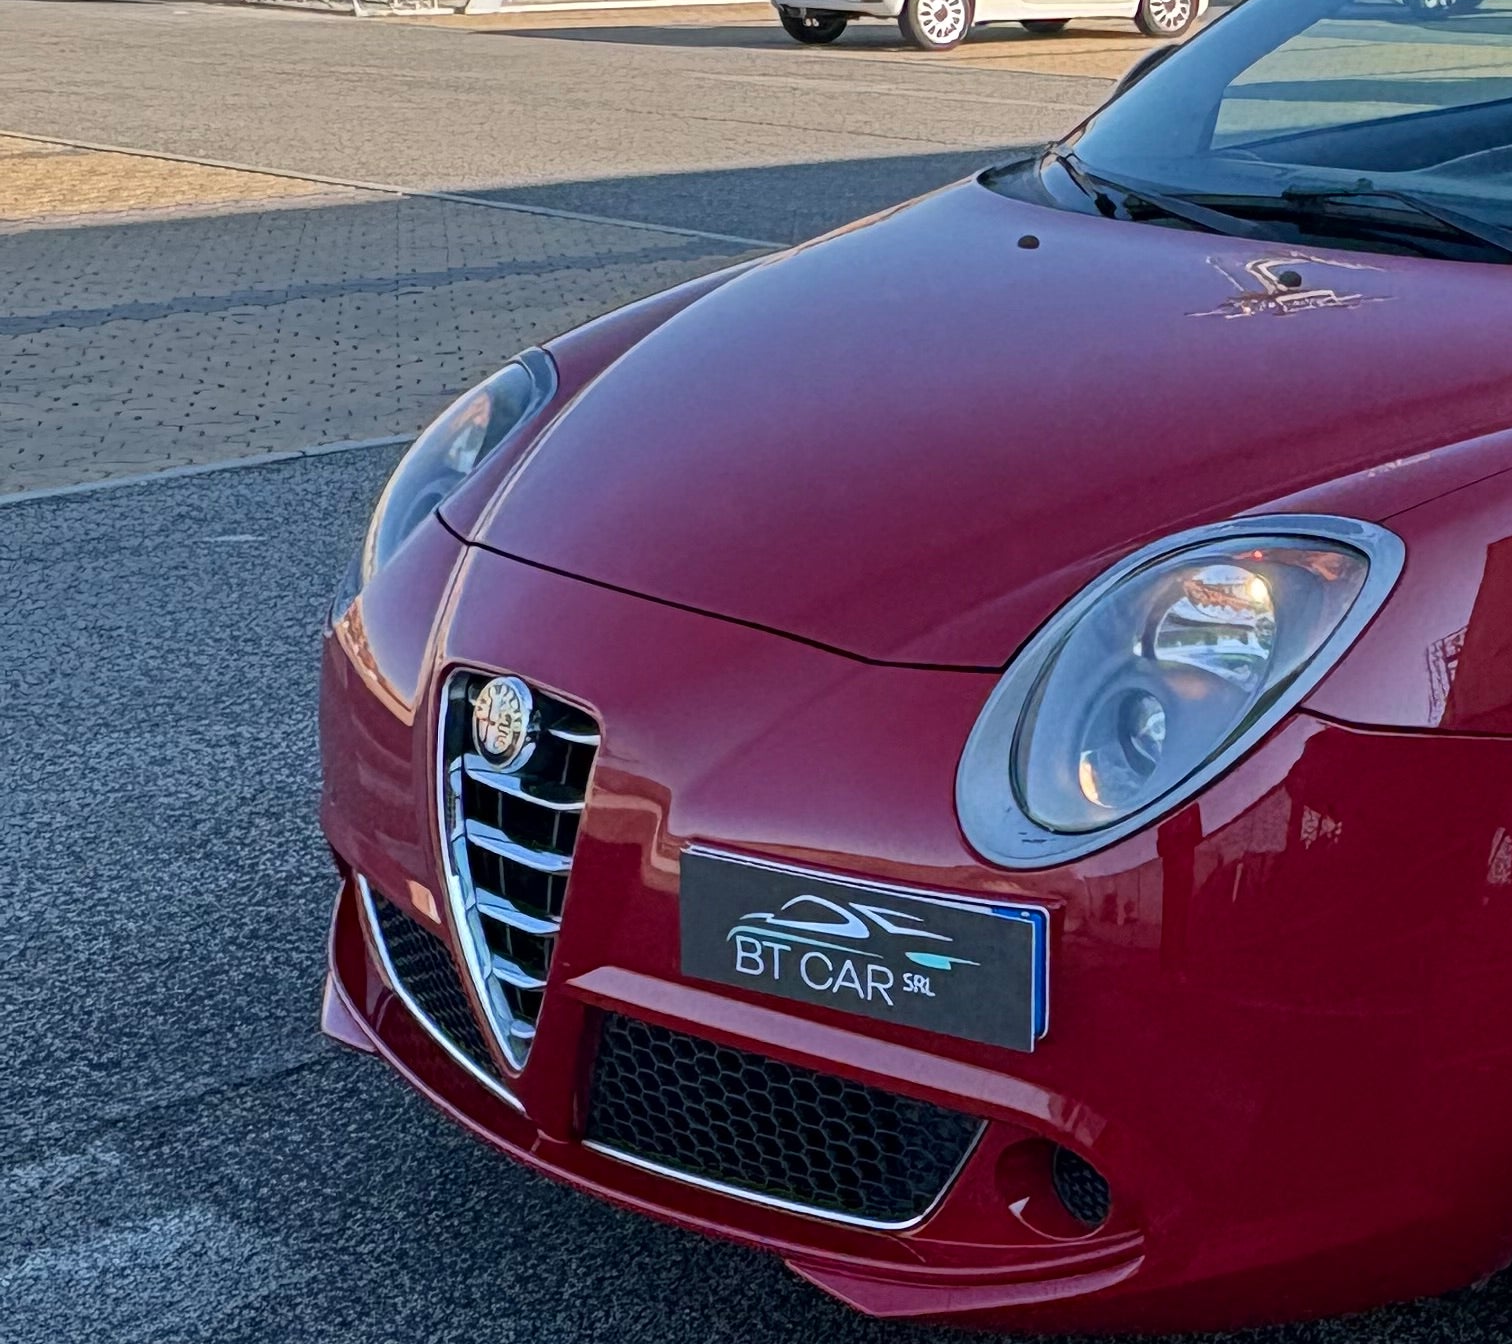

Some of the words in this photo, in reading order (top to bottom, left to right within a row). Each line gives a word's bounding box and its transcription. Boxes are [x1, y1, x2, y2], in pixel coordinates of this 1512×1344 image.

[735, 935, 792, 980] BT
[800, 951, 894, 1006] CAR
[902, 972, 936, 997] SRL
